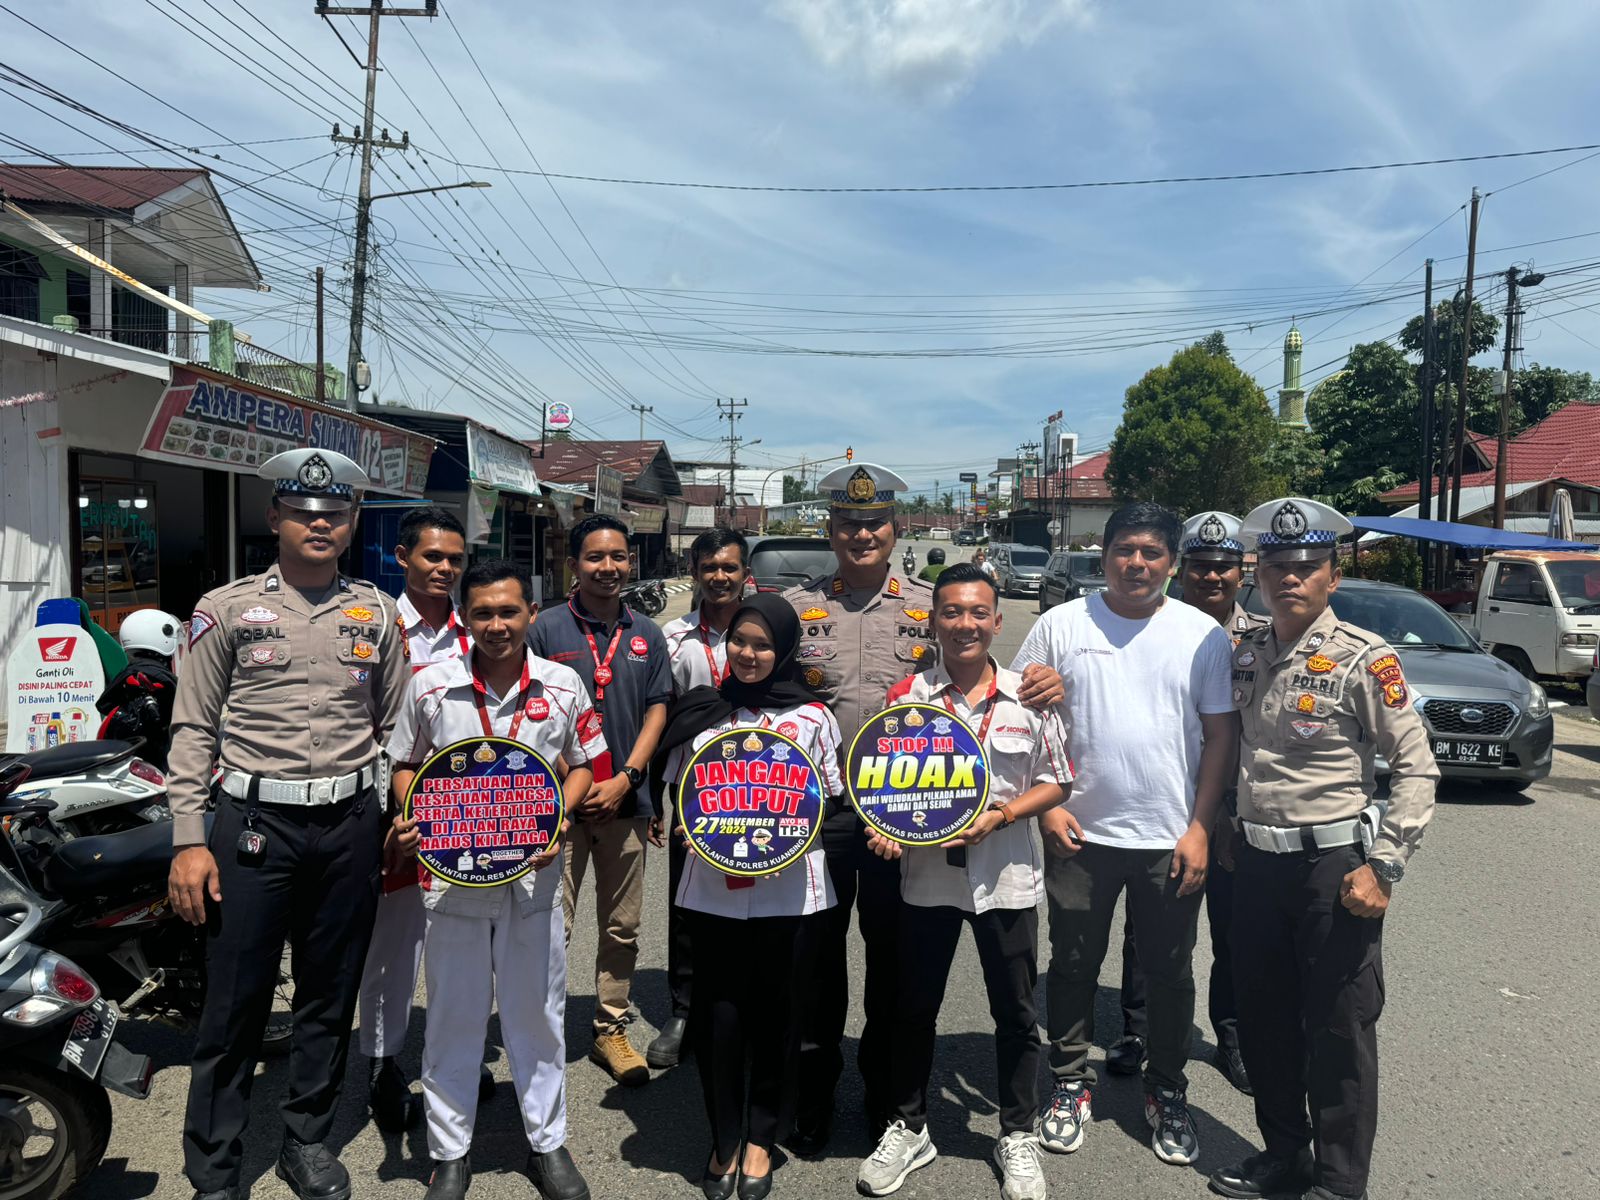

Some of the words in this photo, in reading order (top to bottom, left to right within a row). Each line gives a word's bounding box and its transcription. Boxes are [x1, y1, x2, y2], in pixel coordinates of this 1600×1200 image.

[186, 380, 305, 438] AMPERA
[308, 411, 360, 461] SUTAN
[236, 627, 286, 641] IQBAL
[339, 625, 378, 640] POLRI
[800, 625, 832, 637] OY
[36, 668, 61, 678] Ganti
[62, 667, 74, 676] Oli
[18, 683, 40, 691] DISINI
[40, 682, 68, 690] PALING
[69, 681, 93, 689] CEPAT
[1292, 674, 1336, 693] POLRI
[18, 695, 27, 704] Di
[28, 694, 55, 704] Bawah
[58, 692, 70, 703] 10
[71, 694, 95, 703] Menit
[877, 737, 928, 753] STOP
[932, 737, 954, 753] !!!
[1436, 742, 1450, 754] BM
[1456, 743, 1480, 756] 1622
[1488, 744, 1501, 757] KE
[694, 760, 810, 790] JANGAN
[856, 755, 978, 789] HOAX
[423, 774, 511, 792] PERSATUAN
[514, 773, 545, 787] DAN
[413, 790, 491, 807] KESATUAN
[494, 787, 555, 802] BANGSA
[698, 786, 805, 816] GOLPUT
[860, 796, 880, 806] MARI
[881, 793, 922, 804] WUJUDKAN
[923, 791, 954, 801] PILKADA
[955, 788, 977, 799] AMAN
[887, 802, 911, 812] DAMAI
[912, 801, 928, 811] DAN
[929, 799, 952, 810] SEJUK
[413, 806, 461, 822] SERTA
[464, 801, 554, 818] KETERTIBAN
[431, 821, 449, 835] DI
[452, 819, 497, 834] JALAN
[500, 817, 537, 832] RAYA
[693, 817, 719, 834] 27
[719, 817, 775, 827] NOVEMBER
[719, 825, 747, 834] 2024
[780, 825, 809, 836] TPS
[866, 809, 905, 837] SATLANTAS
[907, 831, 939, 839] POLRES
[941, 808, 973, 835] KUANSING
[420, 836, 471, 851] HARUS
[475, 833, 509, 847] KITA
[512, 830, 549, 845] JAGA
[696, 836, 734, 866] SATLANTAS
[736, 860, 769, 869] POLRES
[770, 838, 805, 865] KUANSING
[425, 853, 468, 880] SATLANTAS
[470, 872, 505, 882] POLRES
[73, 1010, 98, 1042] 3998
[65, 1040, 85, 1064] BM
